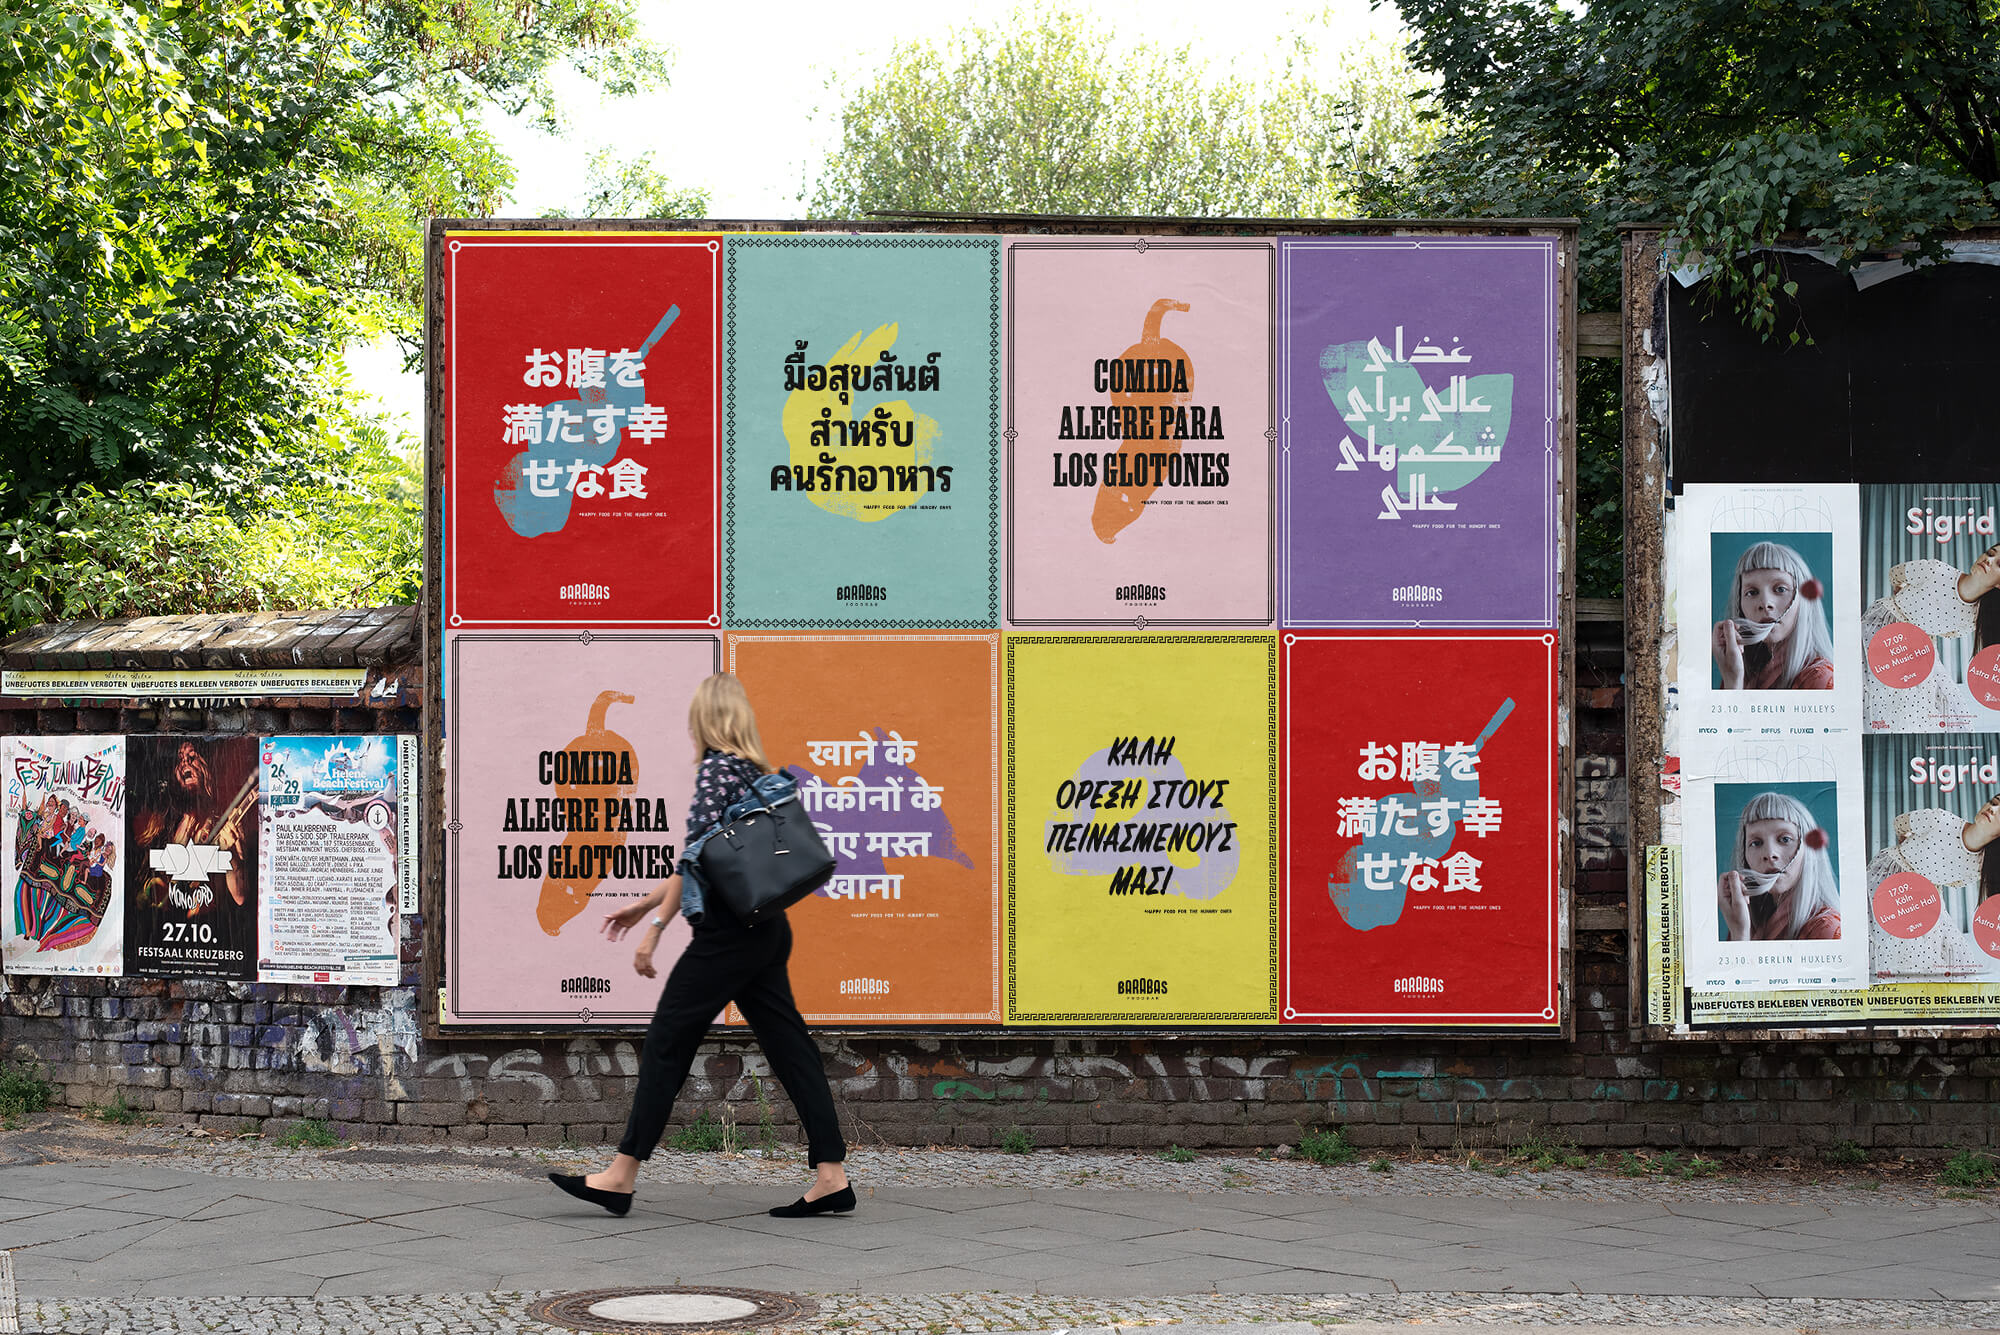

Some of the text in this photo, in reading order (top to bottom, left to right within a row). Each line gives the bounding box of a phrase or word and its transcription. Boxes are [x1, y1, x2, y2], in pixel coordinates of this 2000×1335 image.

[523, 348, 646, 389] お腹を
[783, 340, 942, 406] มื้อสุขสันต์
[1094, 358, 1189, 393] COMIDA
[502, 404, 668, 445] 満たす幸
[810, 407, 914, 448] สำหรับ
[1058, 405, 1225, 440] ALEGRE PARA
[522, 458, 649, 499] せな食
[770, 452, 954, 493] คนรักอาหาร
[1053, 452, 1230, 487] LOS GLOTONES
[1906, 506, 1994, 544] Sigrid
[560, 583, 610, 600] BARABAS
[836, 583, 887, 601] BARABAS
[1116, 583, 1166, 601] BARABAS
[1392, 584, 1443, 602] BARABAS
[1874, 644, 1931, 674] Live Music Hall
[1889, 644, 1908, 657] Köln
[52, 680, 88, 688] BEKLEBEN
[90, 680, 128, 688] VERBOTEN
[131, 680, 258, 689] UNBEFUGTES BEKLEBEN VERBOTEN
[311, 679, 350, 687] BEKLEBEN
[1750, 705, 1786, 713] BERLIN
[1794, 705, 1836, 713] HUXLEYS
[806, 730, 919, 766] खाने के
[1107, 735, 1176, 766] ΚΑΛΗ
[1357, 740, 1481, 782] お腹を
[539, 750, 634, 786] COMIDA
[1909, 755, 1998, 792] Sigrid
[284, 780, 300, 794] 29.
[908, 776, 945, 812] के
[1056, 779, 1230, 810] ΟΡΕΞΗ ΣΤΟΥΣ
[502, 797, 670, 833] ALEGRE PARA
[1336, 796, 1502, 838] 満たす幸
[864, 832, 933, 858] मस्त
[1046, 822, 1238, 853] ΠΕΙΝΑΣΜΕΝΟΥΣ
[497, 844, 675, 880] LOS GLOTONES
[1356, 851, 1483, 893] せな食
[823, 874, 905, 900] खाना
[1895, 894, 1914, 907] Köln
[1880, 894, 1937, 924] Live Music Hall
[162, 922, 218, 944] 27.10.
[1661, 847, 1671, 1022] UNBEFUGTES BEKLEBEN VERBOTEN
[138, 946, 244, 961] FESTSAAL KREUZBERG
[1758, 955, 1793, 964] BERLIN
[1801, 955, 1843, 964] HUXLEYS
[561, 976, 611, 993] BARABAS
[840, 977, 890, 994] BARABAS
[1117, 977, 1168, 995] BARABAS
[1394, 975, 1444, 993] BARABAS
[1691, 998, 1863, 1010] UNBEFUGTES BEKLEBEN VERBOTEN
[1867, 996, 1931, 1005] UNBEFUGTES
[1934, 995, 1984, 1005] BEKLEBEN
